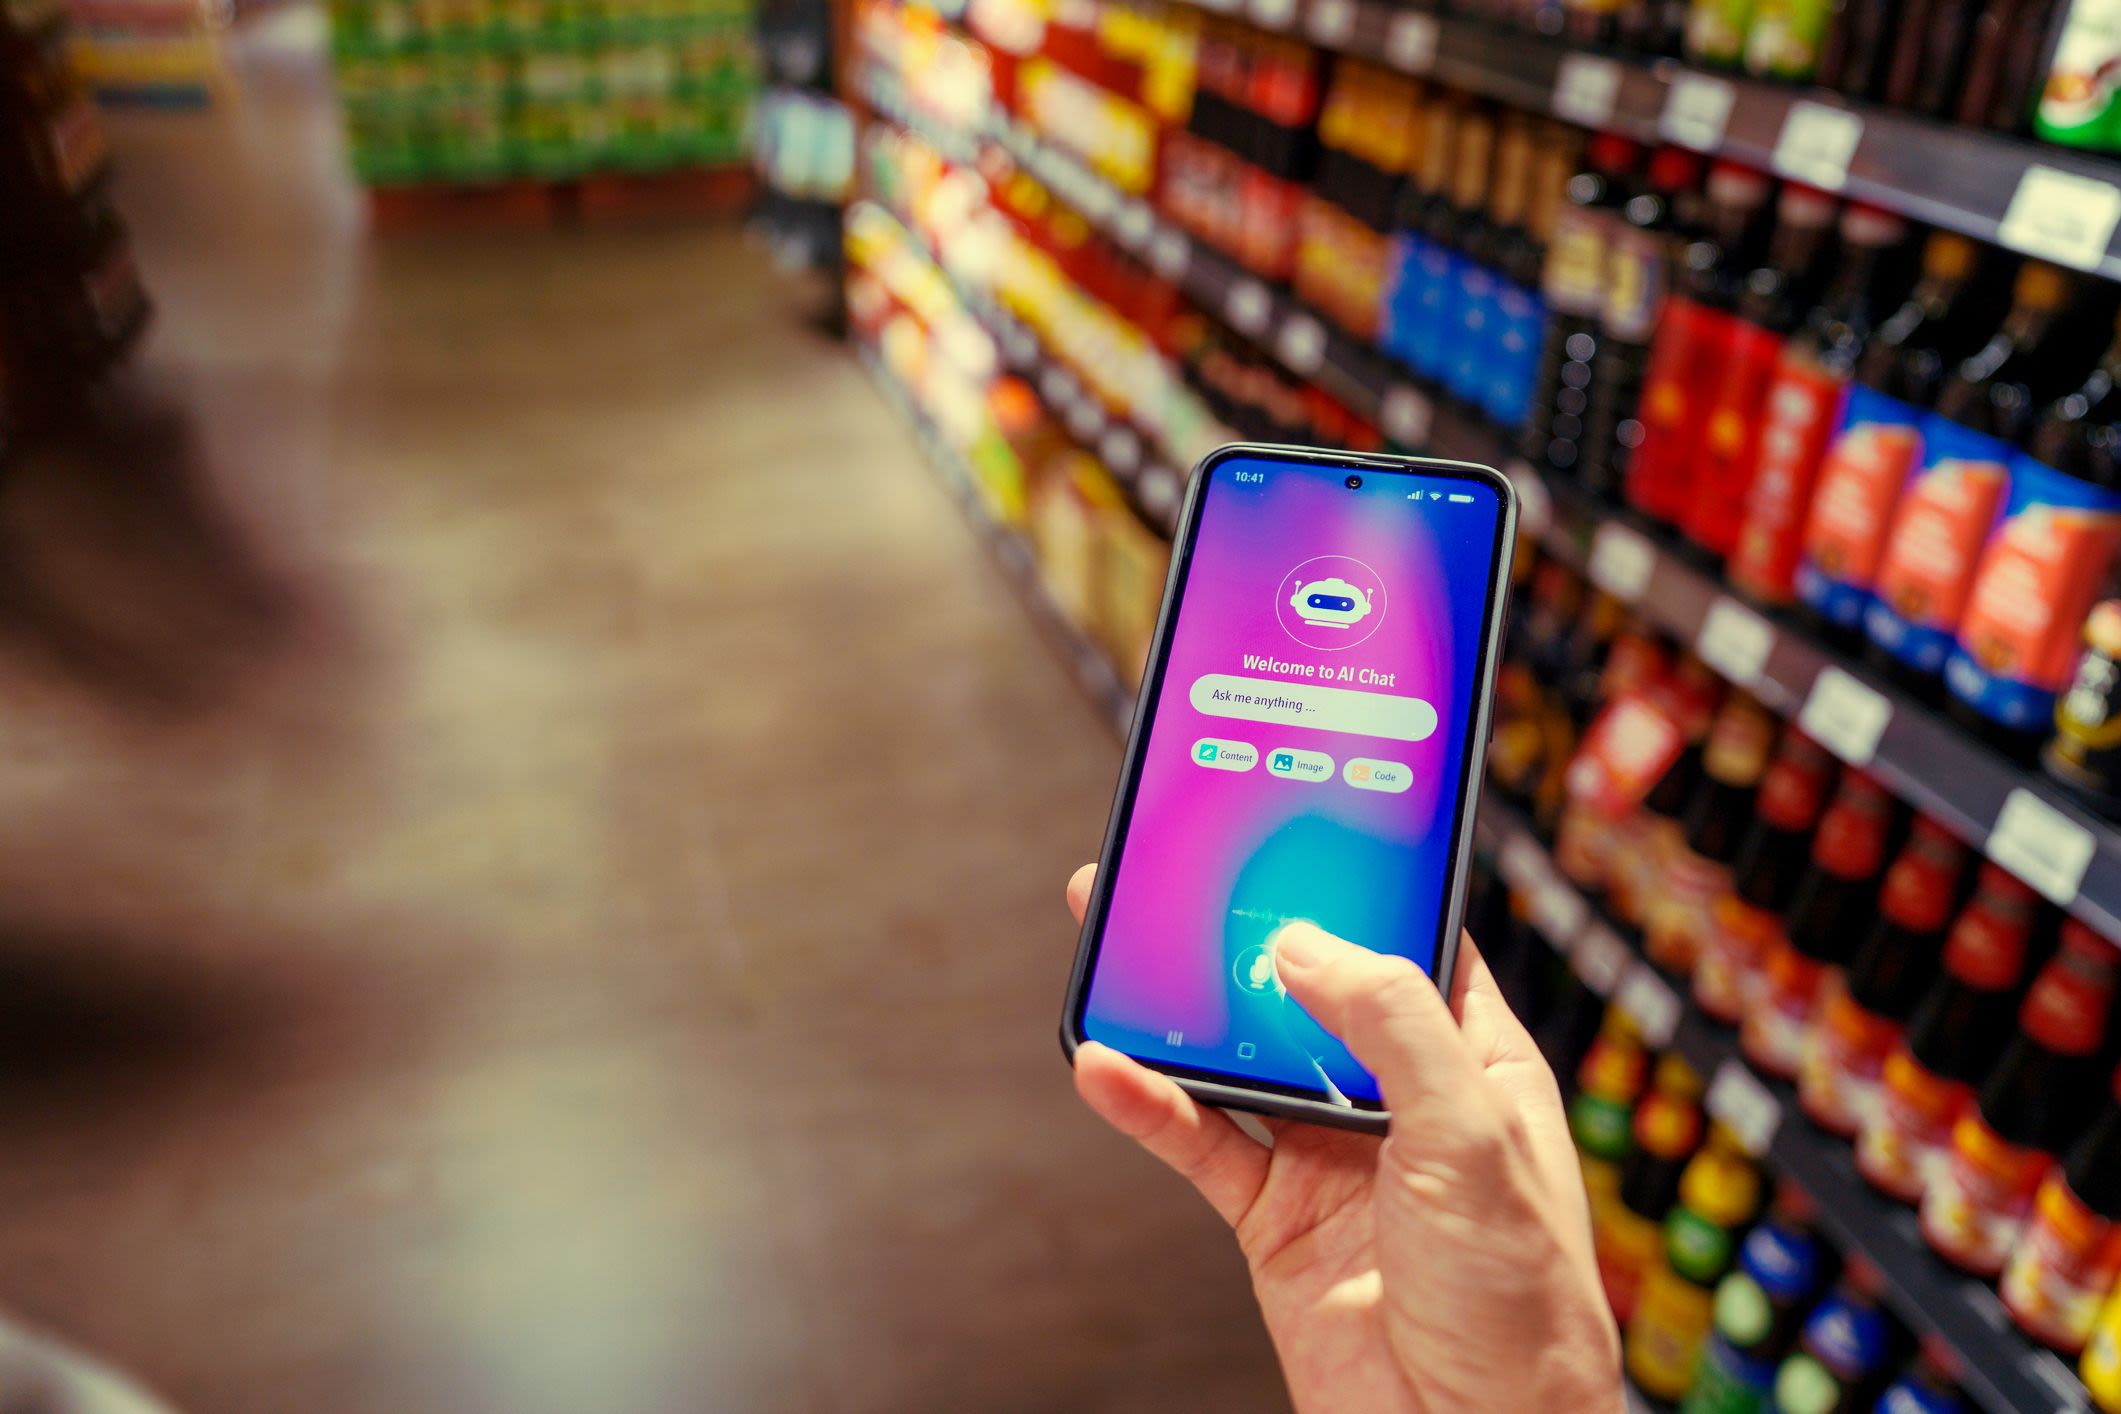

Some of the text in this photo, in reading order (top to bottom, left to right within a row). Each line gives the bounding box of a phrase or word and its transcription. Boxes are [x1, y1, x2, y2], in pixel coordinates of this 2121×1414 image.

[1235, 471, 1264, 484] 10:41
[1243, 654, 1395, 687] Welcome to AI Chat
[1212, 688, 1231, 702] Ask
[1234, 693, 1251, 704] me
[1254, 694, 1303, 713] anything
[1220, 750, 1253, 763] Content
[1297, 760, 1324, 773] Image
[1374, 770, 1397, 782] Code
